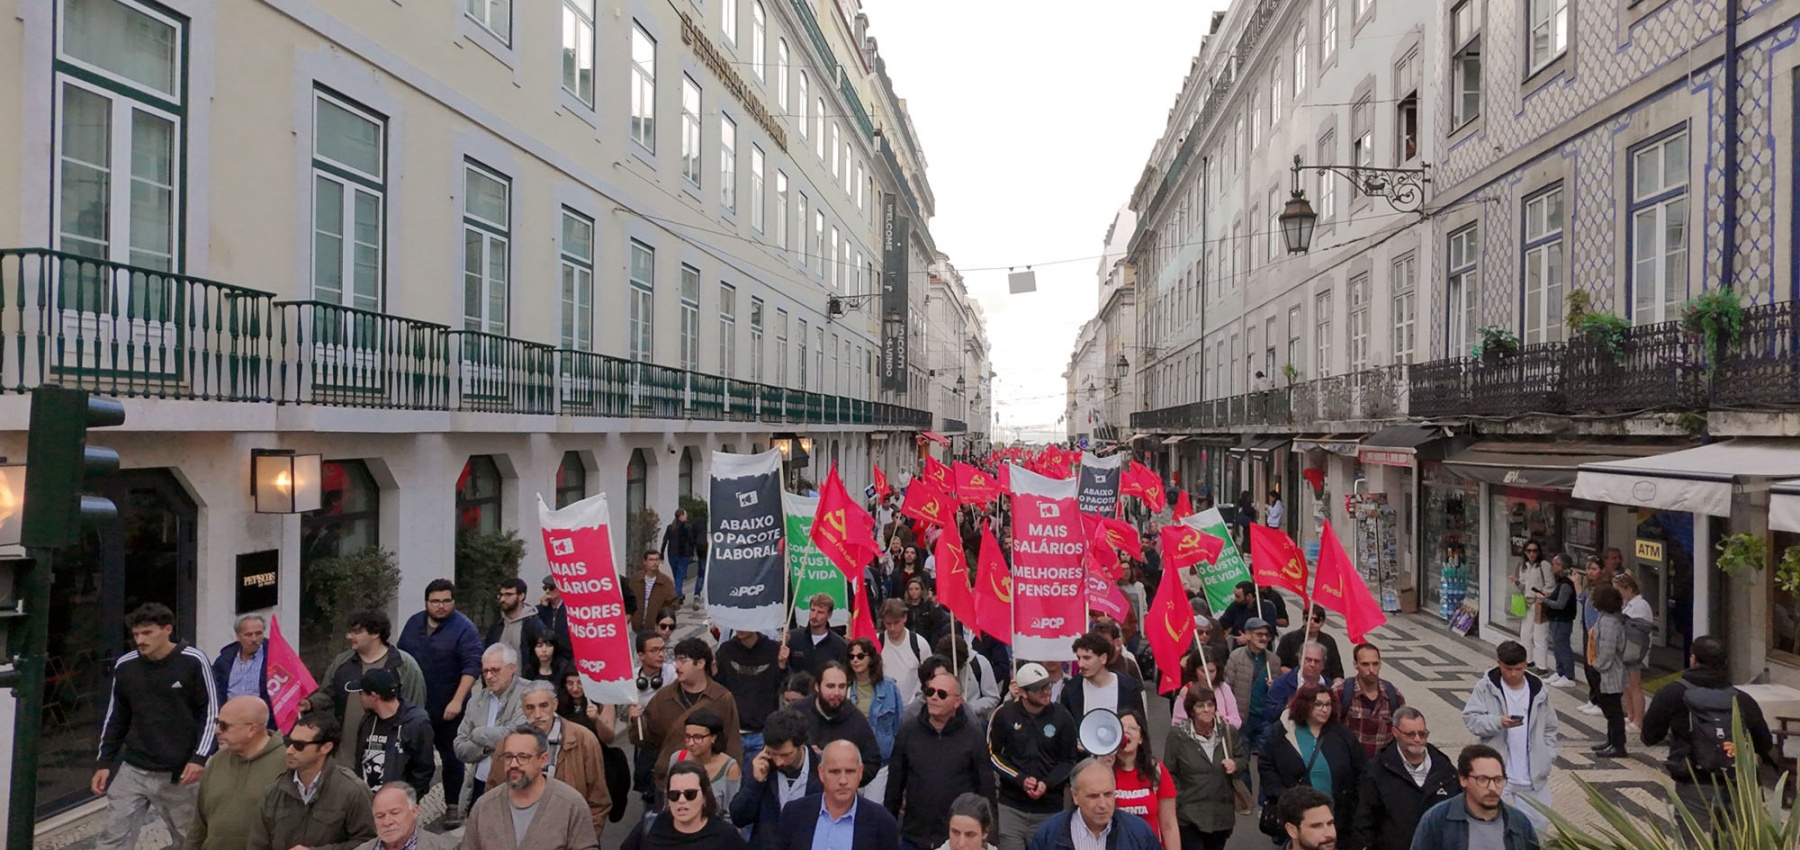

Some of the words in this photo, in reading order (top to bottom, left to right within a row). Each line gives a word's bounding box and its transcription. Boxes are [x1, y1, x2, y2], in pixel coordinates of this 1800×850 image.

[1083, 488, 1113, 496] ABAIXO
[1086, 496, 1115, 504] PACOTE
[720, 515, 774, 530] ABAIXO
[713, 532, 724, 543] O
[727, 528, 780, 544] PACOTE
[1028, 523, 1067, 538] MAIS
[716, 538, 784, 560] LABORAL!
[1013, 538, 1083, 555] SALÁRIOS
[1639, 544, 1660, 557] ATM
[791, 554, 798, 563] O
[799, 556, 830, 567] CUST
[1199, 567, 1206, 575] O
[1206, 556, 1239, 573] CUSTO
[550, 561, 587, 576] MAIS
[807, 570, 838, 580] VIDA
[1014, 565, 1082, 579] MELHORES
[1204, 576, 1218, 585] DE
[1217, 567, 1243, 583] VIDA
[739, 584, 765, 597] PCP
[1018, 582, 1078, 597] PENSÕES
[1041, 617, 1065, 629] PCP
